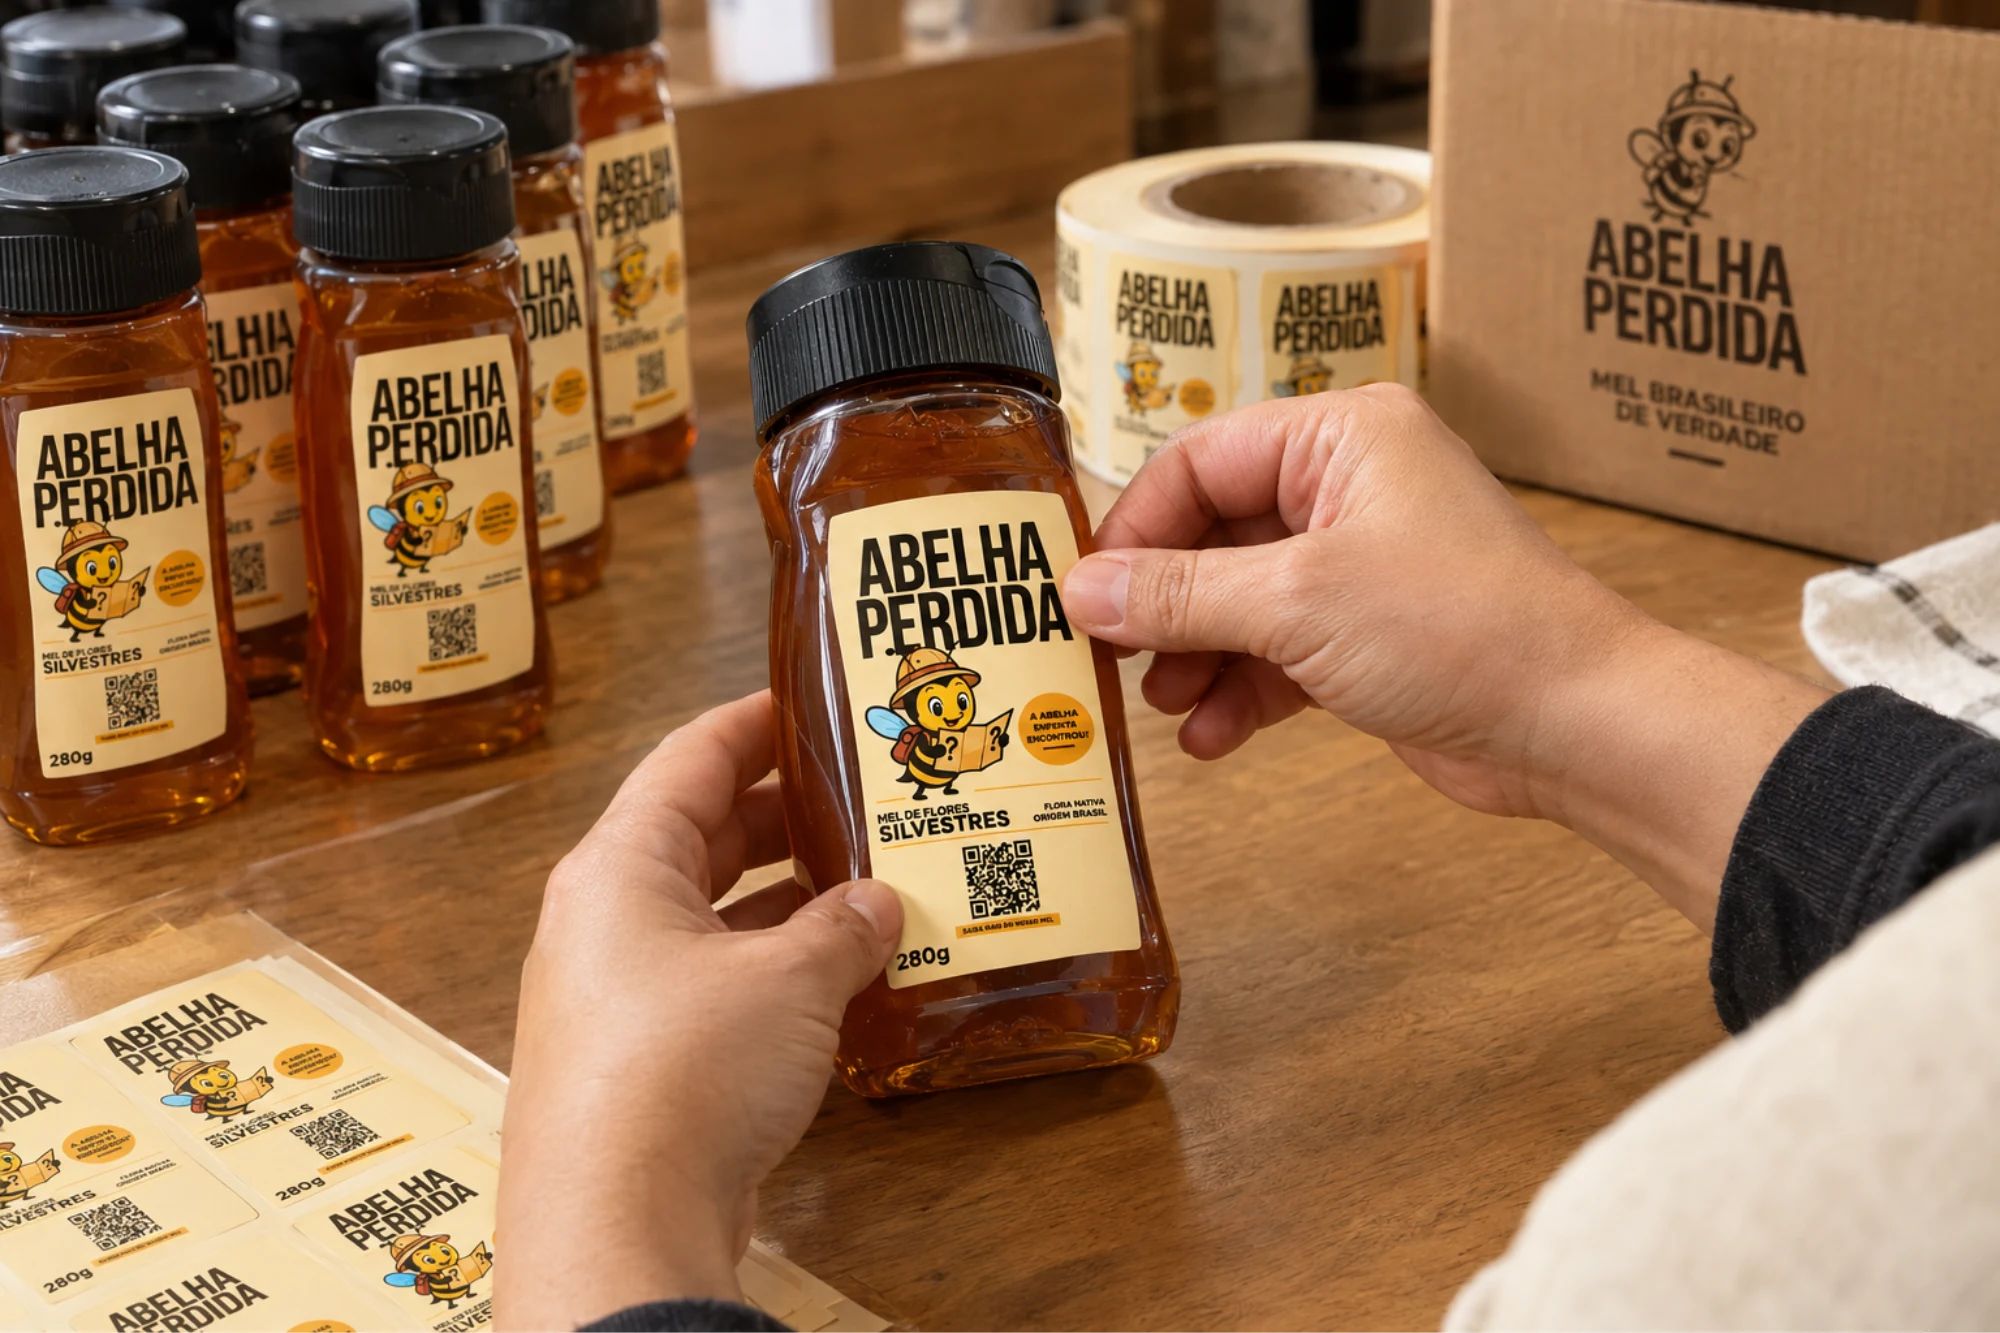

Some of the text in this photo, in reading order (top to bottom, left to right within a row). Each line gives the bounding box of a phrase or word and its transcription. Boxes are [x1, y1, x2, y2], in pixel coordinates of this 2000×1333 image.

[598, 146, 672, 199] ABELHA
[596, 182, 677, 239] PERDIDA
[1587, 217, 1793, 308] ABELHA
[1119, 269, 1211, 314] ABELHA
[1277, 279, 1382, 320] ABELHA
[1116, 303, 1215, 350] PERDIDA
[1273, 312, 1386, 354] PERDIDA
[1583, 276, 1808, 377] PERDIDA
[370, 361, 506, 423] ABELHA
[1590, 368, 1805, 434] MEL BRASILEIRO
[36, 415, 189, 480] ABELHA
[367, 406, 514, 469] PERDIDA
[1615, 399, 1780, 456] DE VERDADE
[33, 461, 199, 528] PERDIDA
[859, 520, 1053, 597] ABELHA
[370, 582, 463, 608] SILVESTRES
[856, 581, 1073, 659] PERDIDA
[43, 647, 142, 674] SILVESTRES
[371, 679, 413, 695] 280g
[1030, 709, 1078, 720] A ABELHA
[49, 750, 93, 768] 280g
[877, 803, 970, 824] MEL DE FLORES
[879, 810, 1010, 843] SILVESTRES
[1072, 808, 1107, 819] BRASIL
[897, 947, 950, 971] 280g
[103, 992, 239, 1057] ABELHA
[119, 1009, 268, 1075] PERDIDA
[210, 1103, 314, 1149] SILVESTRES
[275, 1177, 326, 1201] 280g
[328, 1168, 455, 1235] ABELHA
[345, 1182, 479, 1251] PERDIDA
[43, 1266, 94, 1294] 280g
[108, 1267, 242, 1333] ABELHA
